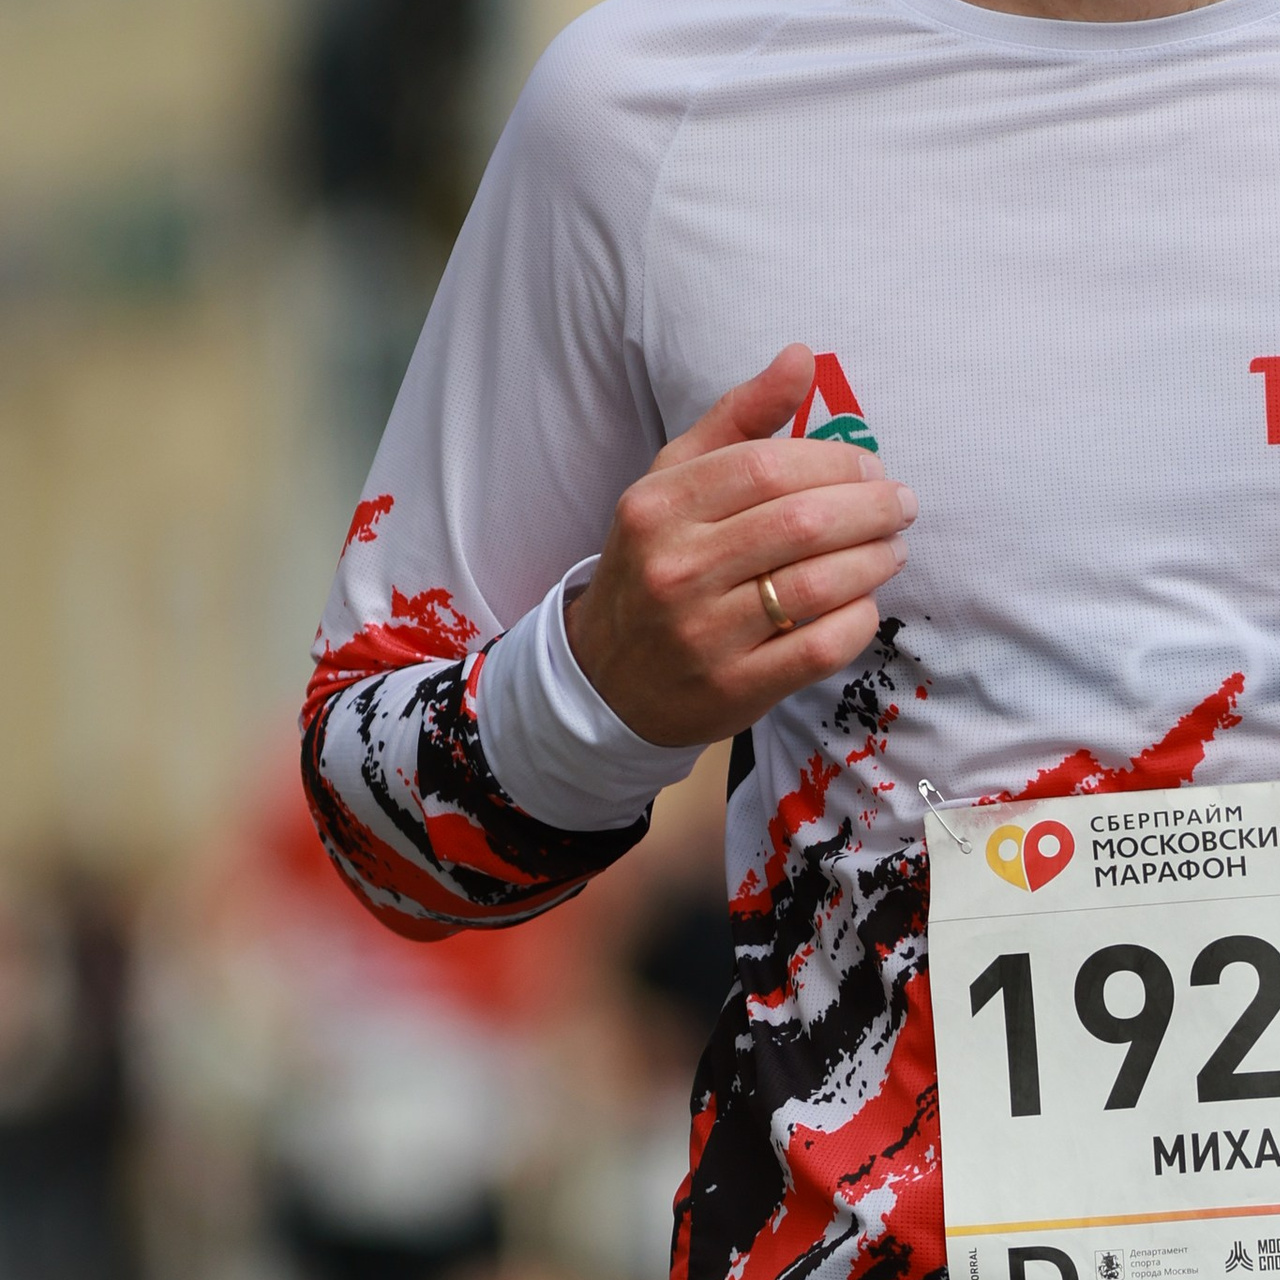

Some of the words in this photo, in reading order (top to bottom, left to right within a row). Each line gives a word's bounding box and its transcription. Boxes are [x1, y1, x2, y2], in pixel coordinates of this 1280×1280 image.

[1090, 804, 1243, 833] СБЕРПРАЙМ
[1094, 855, 1247, 888] МАРАФОН
[1130, 1247, 1188, 1259] Департамент
[1130, 1259, 1161, 1268] спорта
[1131, 1270, 1162, 1279] города
[1164, 1267, 1199, 1276] Москвы
